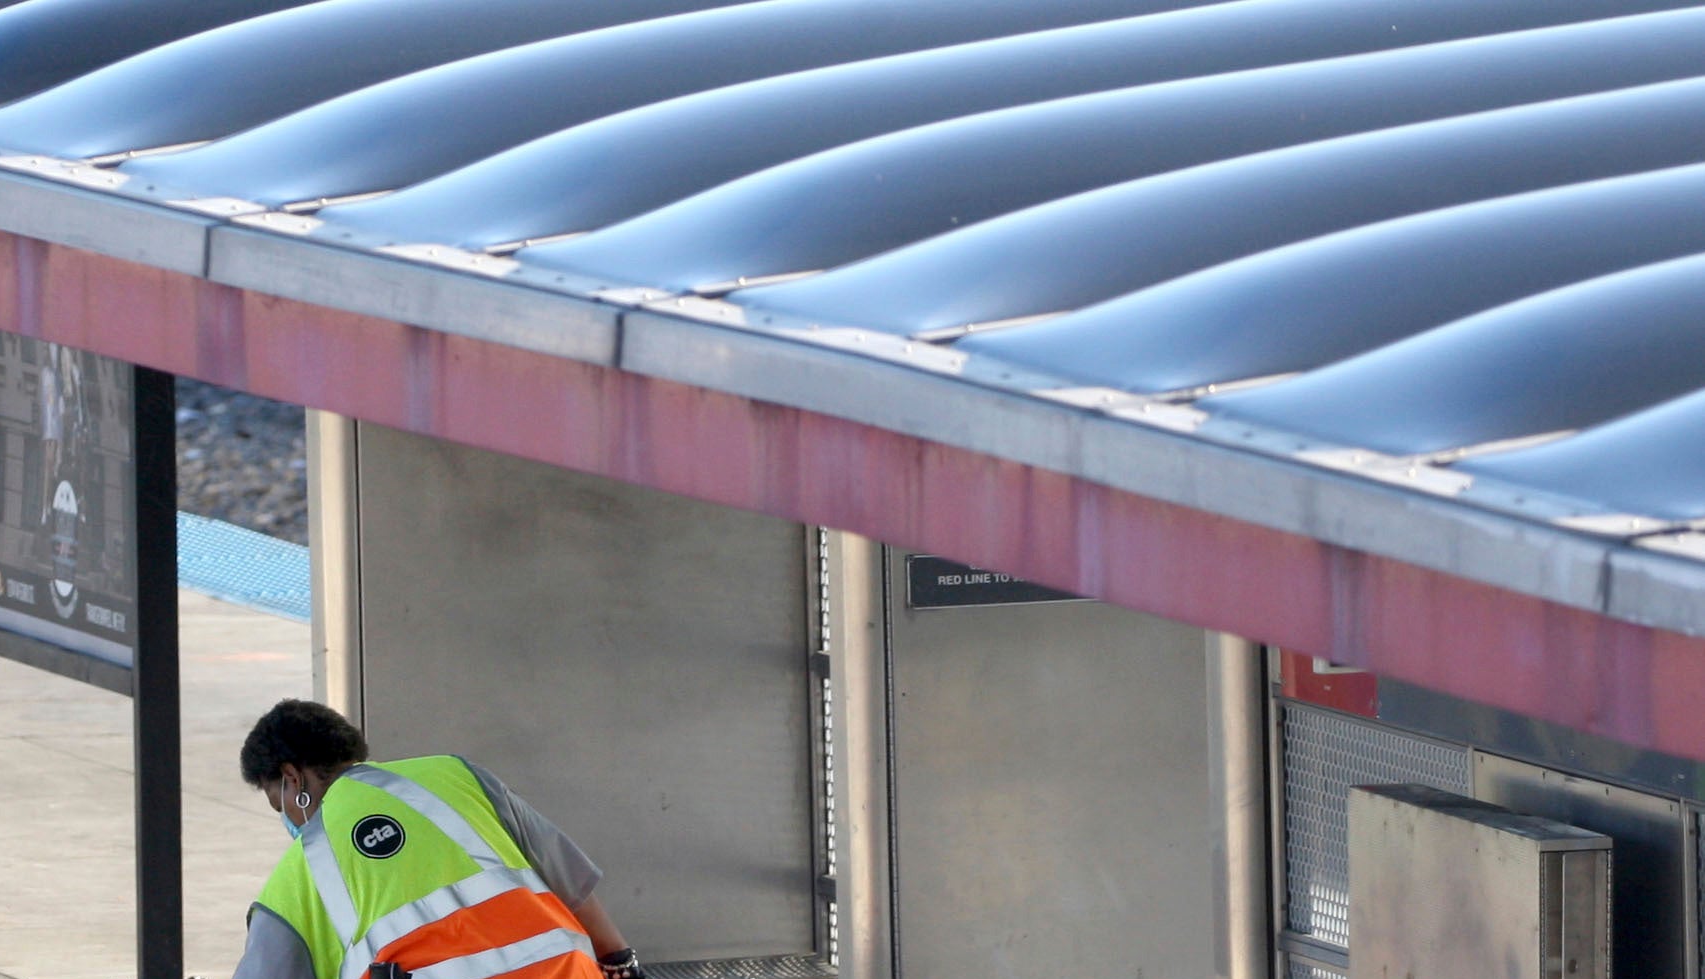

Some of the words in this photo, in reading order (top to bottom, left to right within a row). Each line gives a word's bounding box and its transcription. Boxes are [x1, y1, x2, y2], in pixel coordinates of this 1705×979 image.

[937, 575, 962, 586] RED
[965, 573, 991, 584] LINE
[993, 572, 1010, 583] TO
[363, 824, 398, 848] cta
